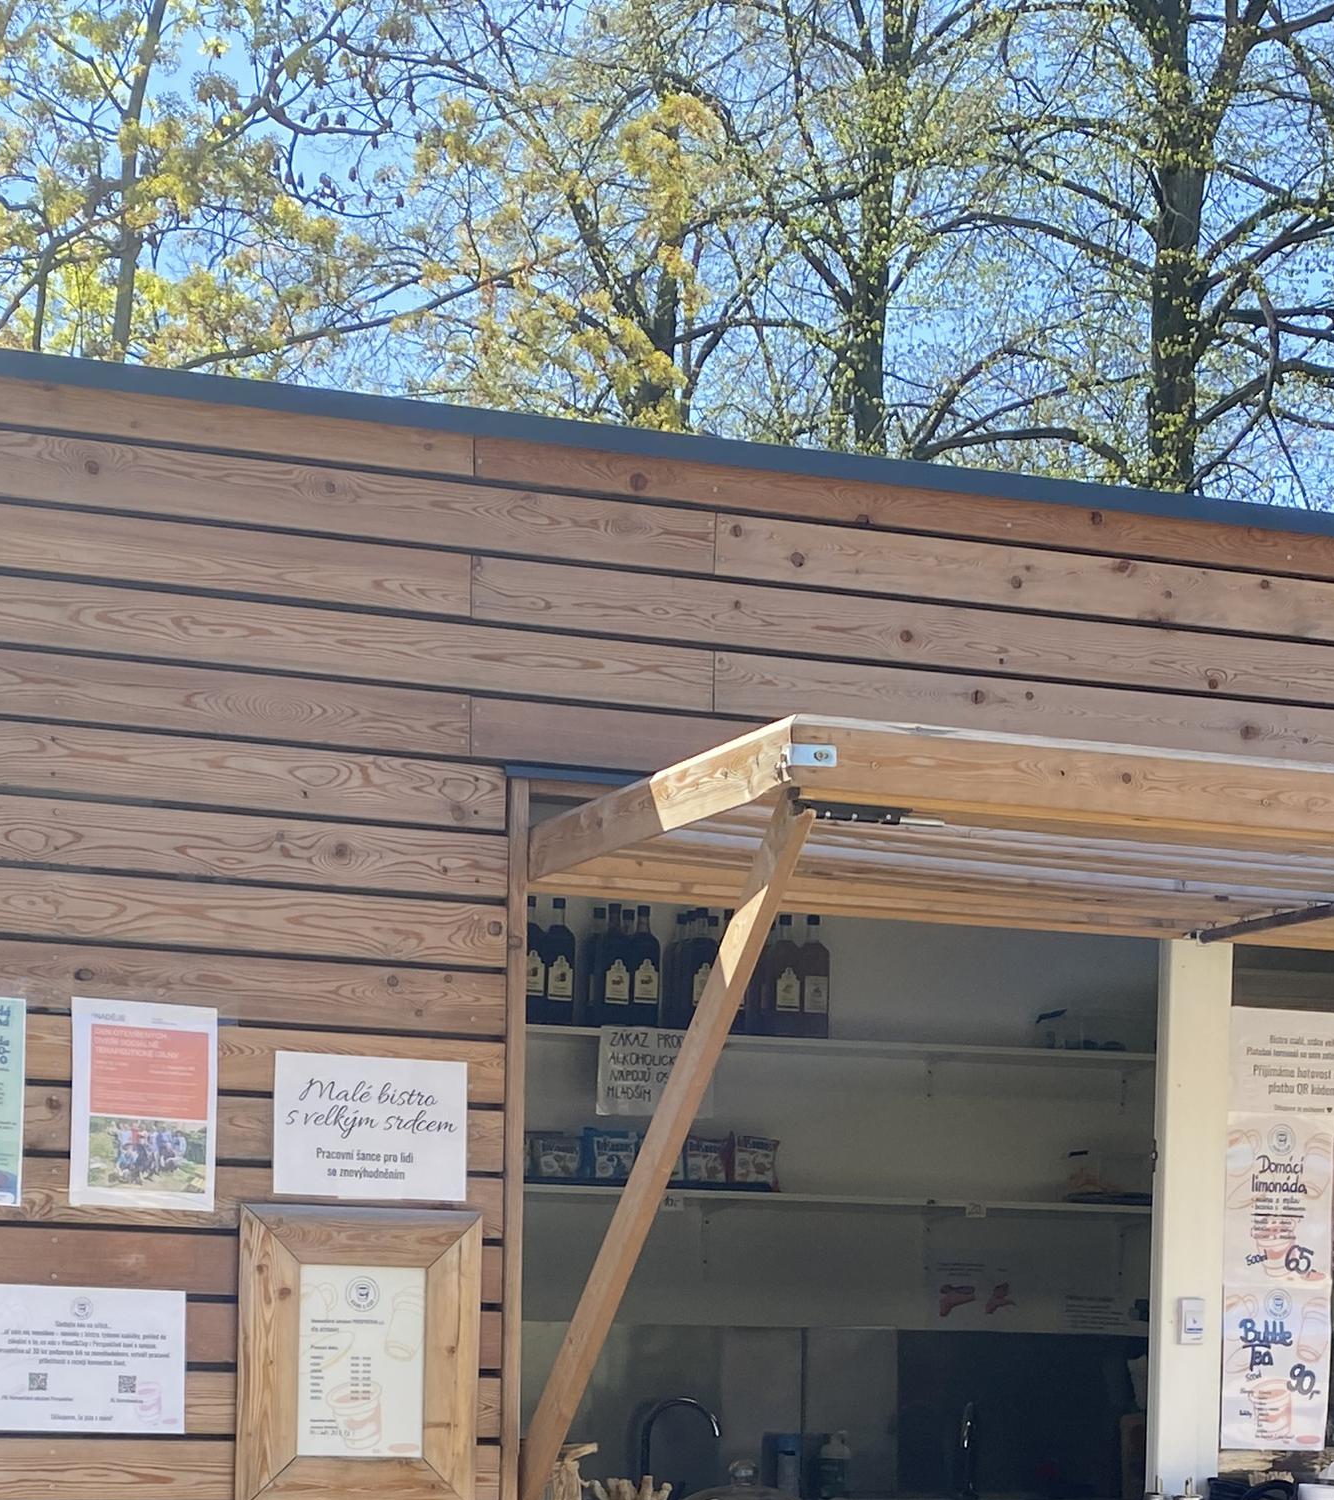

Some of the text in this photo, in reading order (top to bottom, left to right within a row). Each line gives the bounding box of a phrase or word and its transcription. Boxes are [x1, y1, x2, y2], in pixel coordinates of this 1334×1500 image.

[610, 1052, 676, 1066] ALKOHOLICK
[1297, 1067, 1331, 1079] hotovost
[299, 1078, 438, 1107] Malé bistro
[1296, 1083, 1309, 1095] QR
[285, 1105, 458, 1139] s velkým srdcem
[316, 1147, 414, 1163] Pracovní šance pro lidi
[1256, 1154, 1305, 1174] Domácí
[1251, 1174, 1308, 1195] limonáda
[1239, 1318, 1293, 1346] Bubble
[1242, 1344, 1274, 1371] Tea
